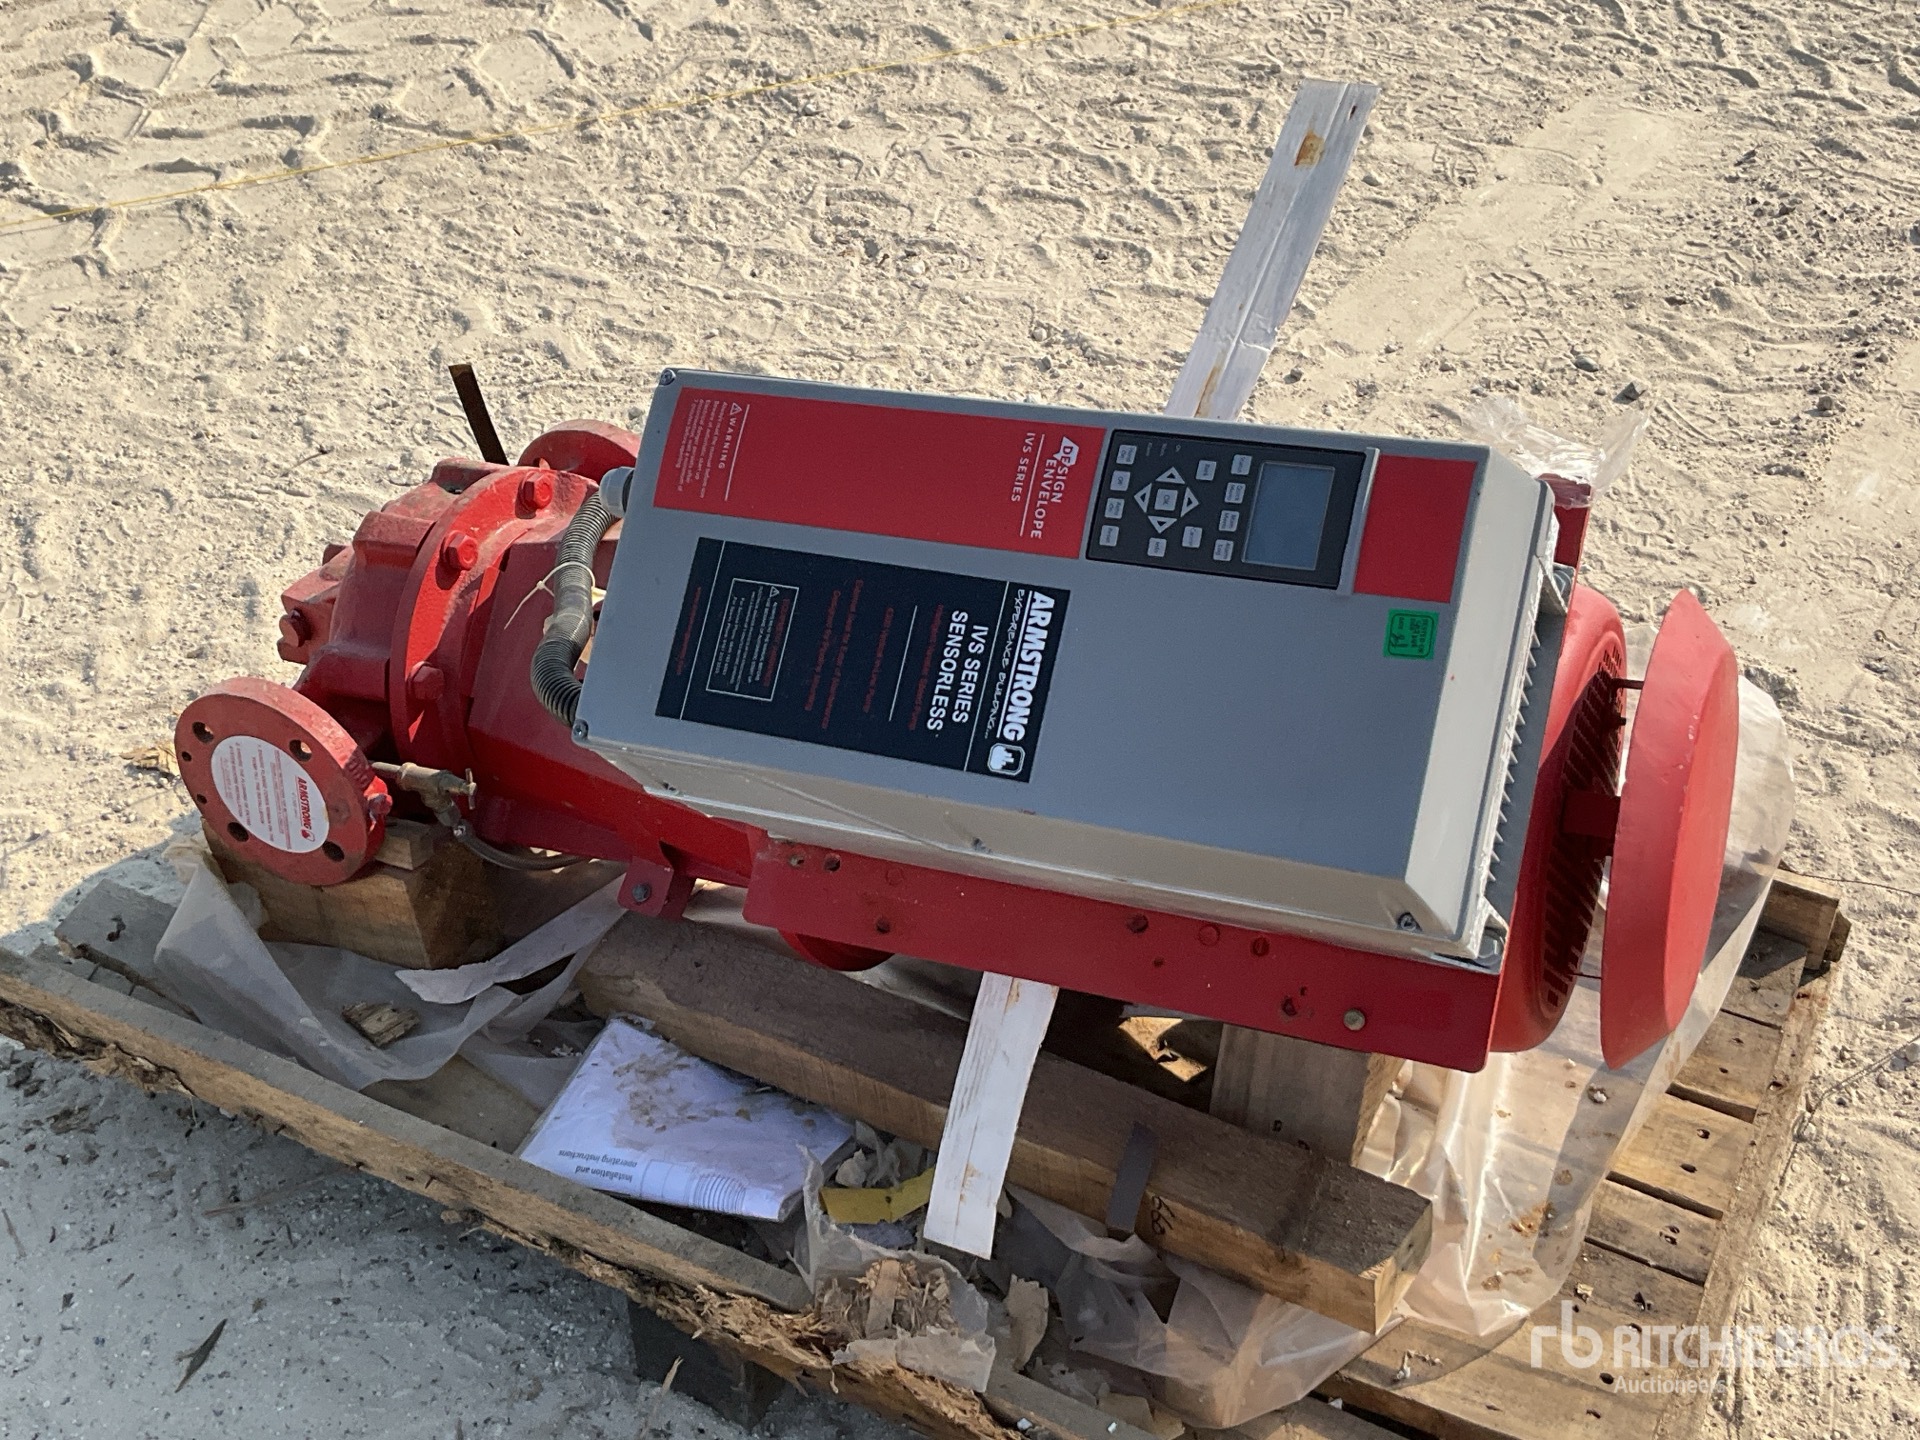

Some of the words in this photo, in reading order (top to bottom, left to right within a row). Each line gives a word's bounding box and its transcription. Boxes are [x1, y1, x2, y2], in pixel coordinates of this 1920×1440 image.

[717, 417, 736, 469] WARNING
[1021, 431, 1035, 453] IVS
[1010, 456, 1029, 502] SERIES
[1029, 458, 1057, 539] ENVELOPE
[1050, 445, 1073, 503] DESIGN
[1163, 495, 1170, 505] OK
[966, 624, 989, 654] IVS
[998, 588, 1025, 669] EXPERIENCE
[925, 609, 968, 731] SENSORLESS
[950, 657, 981, 724] SERIES
[1001, 591, 1056, 742] ARMSTRONG
[297, 776, 312, 830] ARMSTRONG
[558, 1149, 601, 1162] instructions
[574, 1165, 590, 1174] and
[590, 1169, 633, 1183] Installation
[601, 1154, 638, 1168] operating
